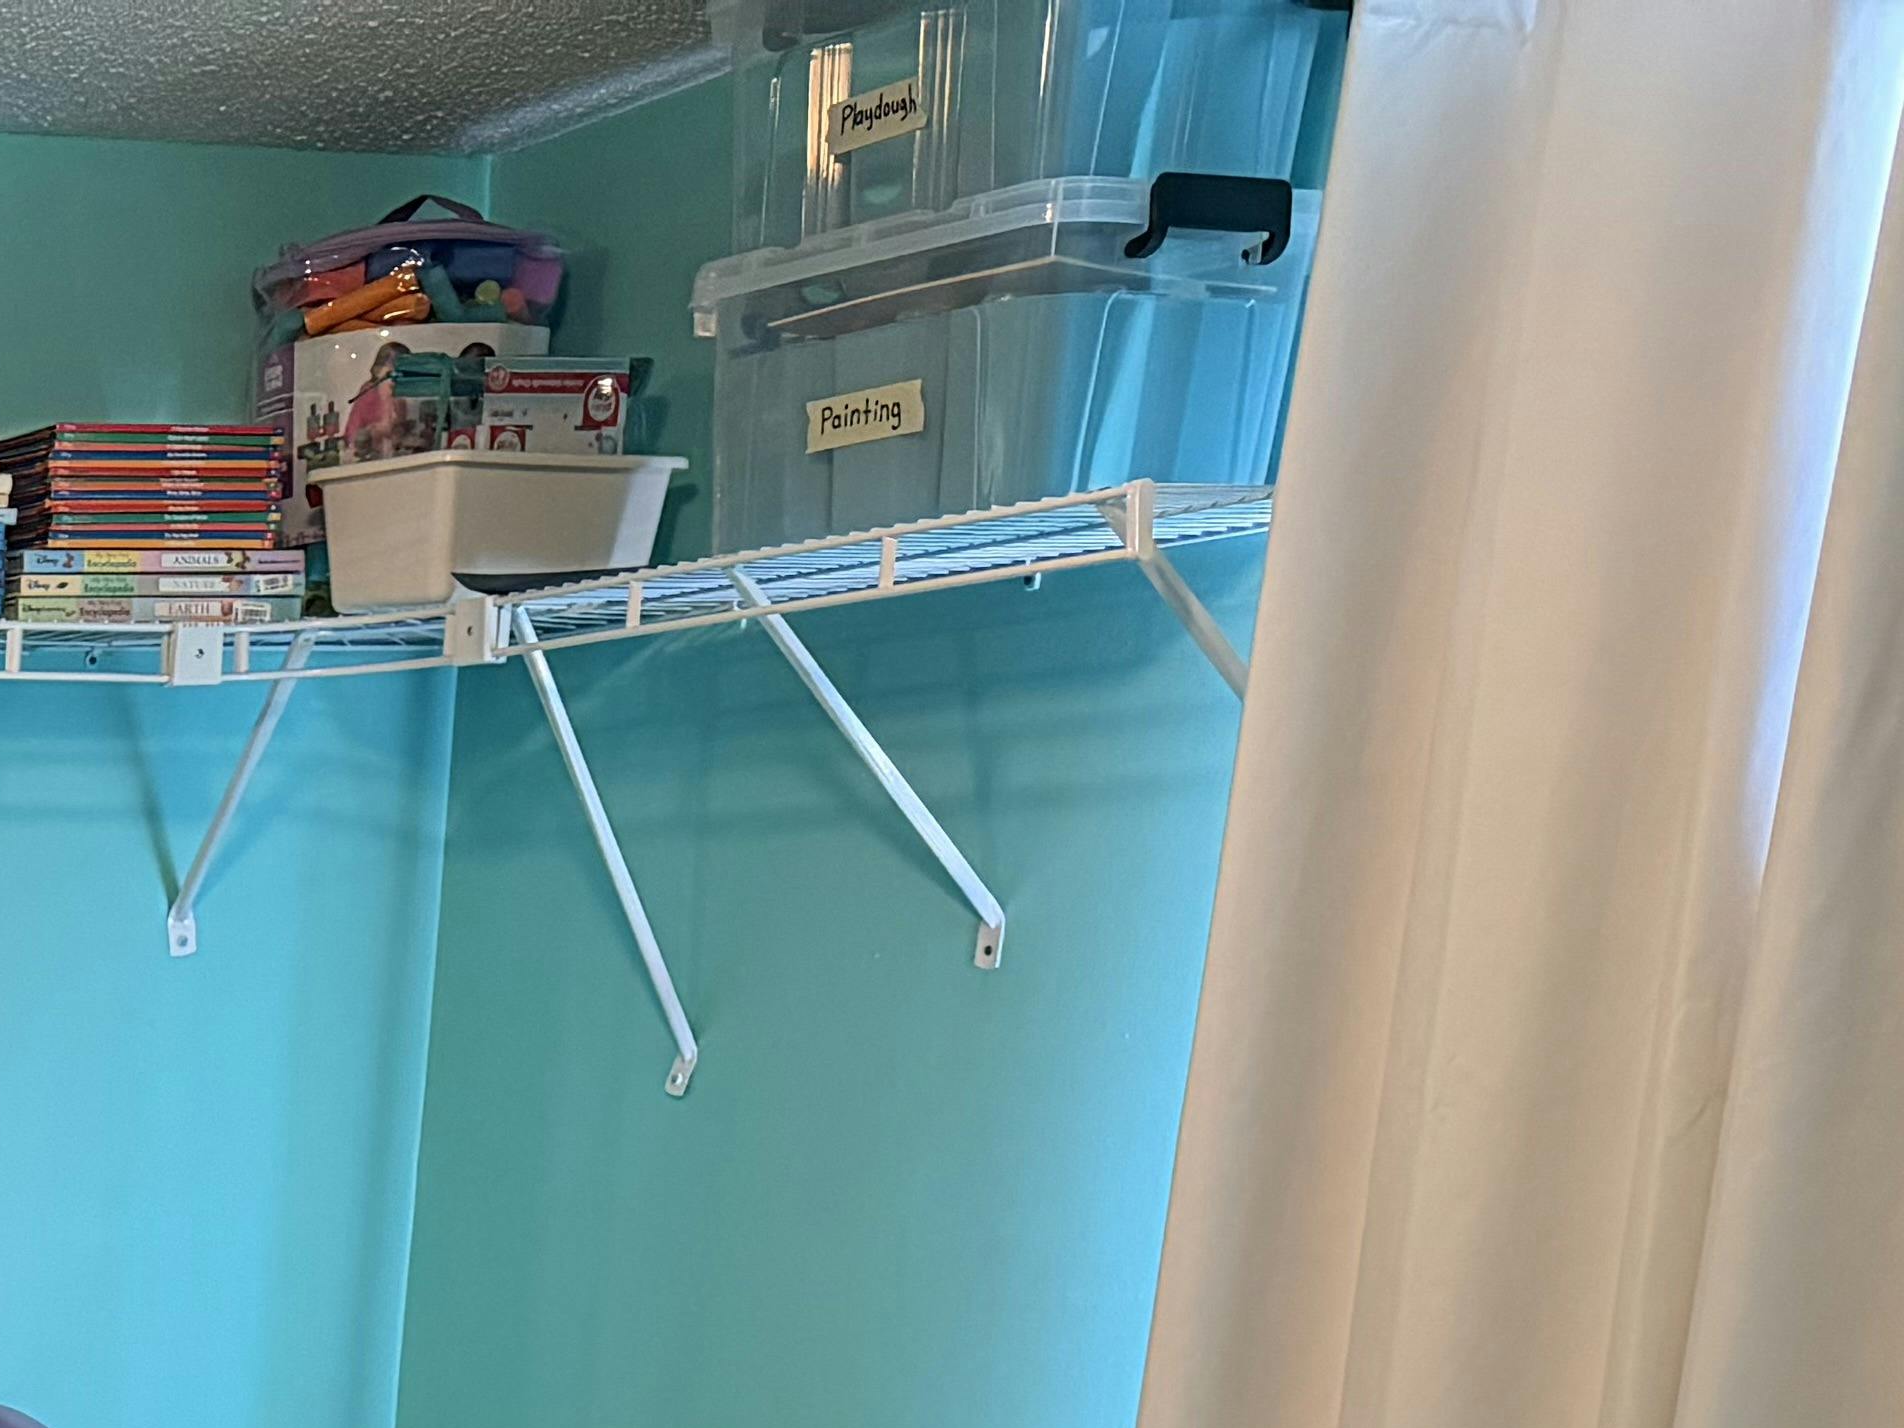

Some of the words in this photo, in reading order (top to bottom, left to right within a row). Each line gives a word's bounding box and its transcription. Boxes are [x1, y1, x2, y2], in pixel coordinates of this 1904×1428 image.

[840, 83, 917, 136] Playdough
[821, 397, 901, 436] Painting
[173, 555, 219, 565] ANIMALS
[168, 602, 209, 615] EARTH
